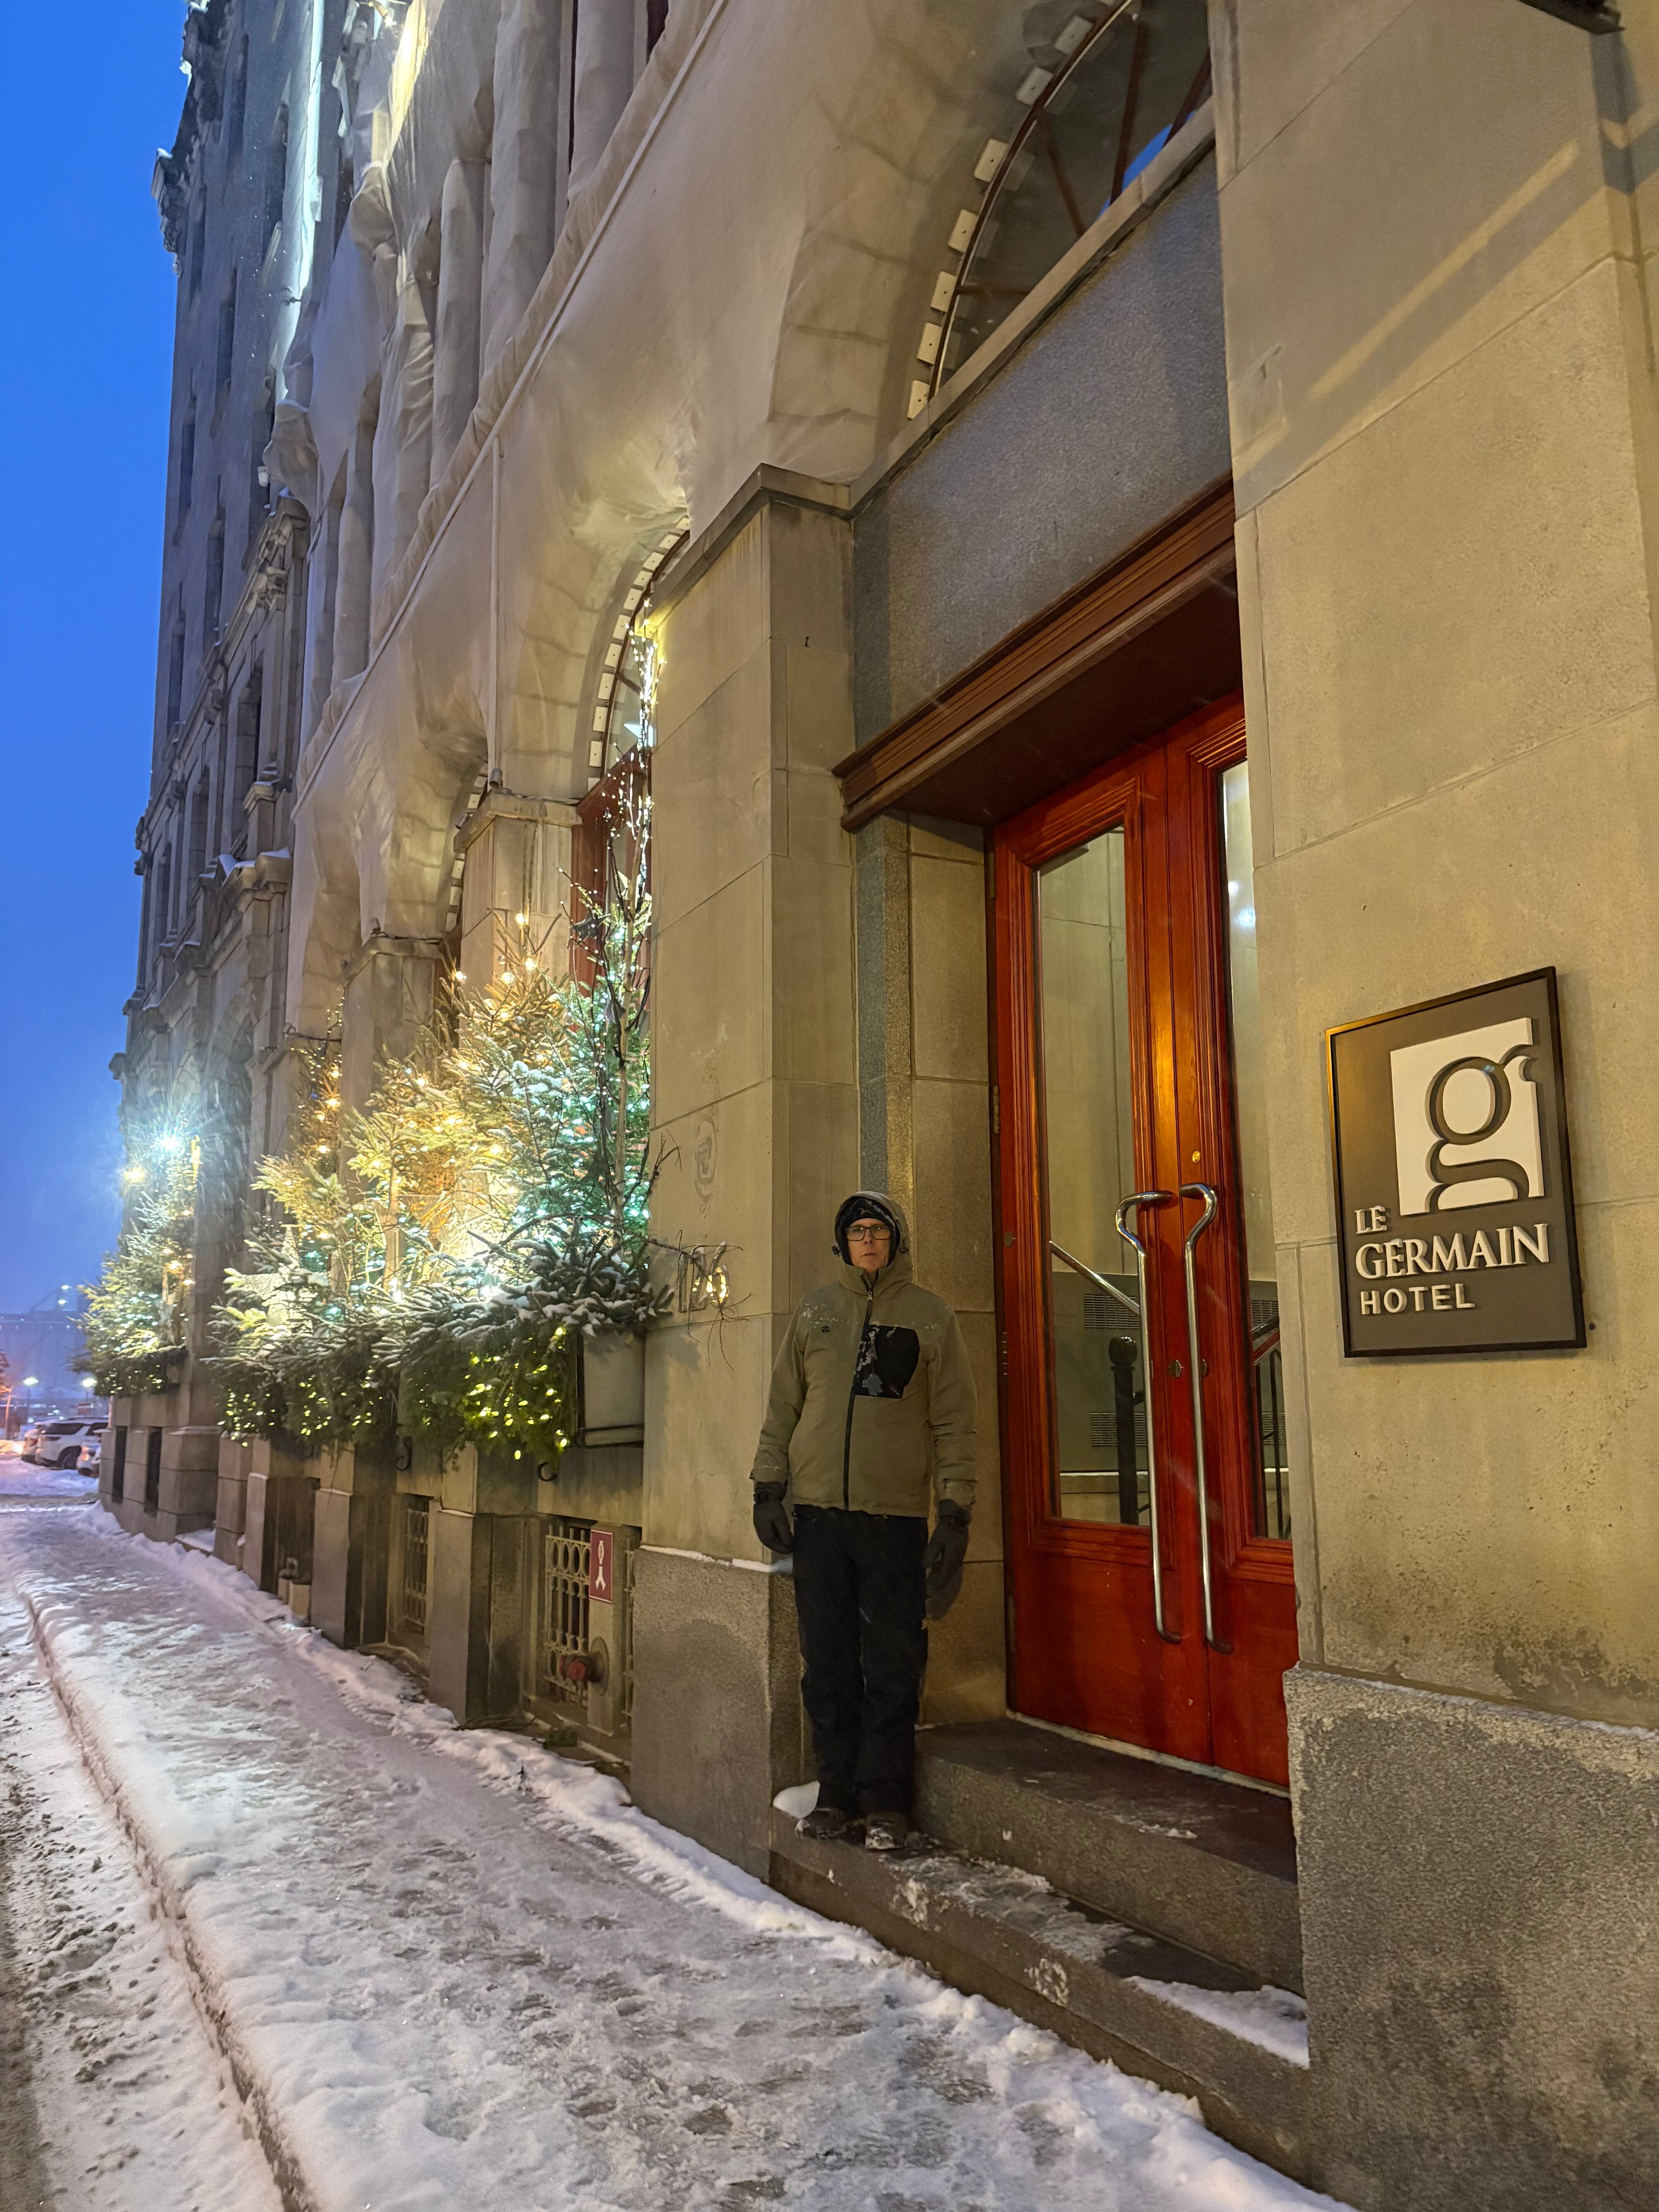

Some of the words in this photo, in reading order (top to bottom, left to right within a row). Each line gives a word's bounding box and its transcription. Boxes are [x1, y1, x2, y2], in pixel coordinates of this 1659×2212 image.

[1354, 1205, 1388, 1234] LE
[1355, 1223, 1549, 1279] GERMAIN
[678, 1240, 729, 1312] 126
[1360, 1283, 1475, 1315] HOTEL
